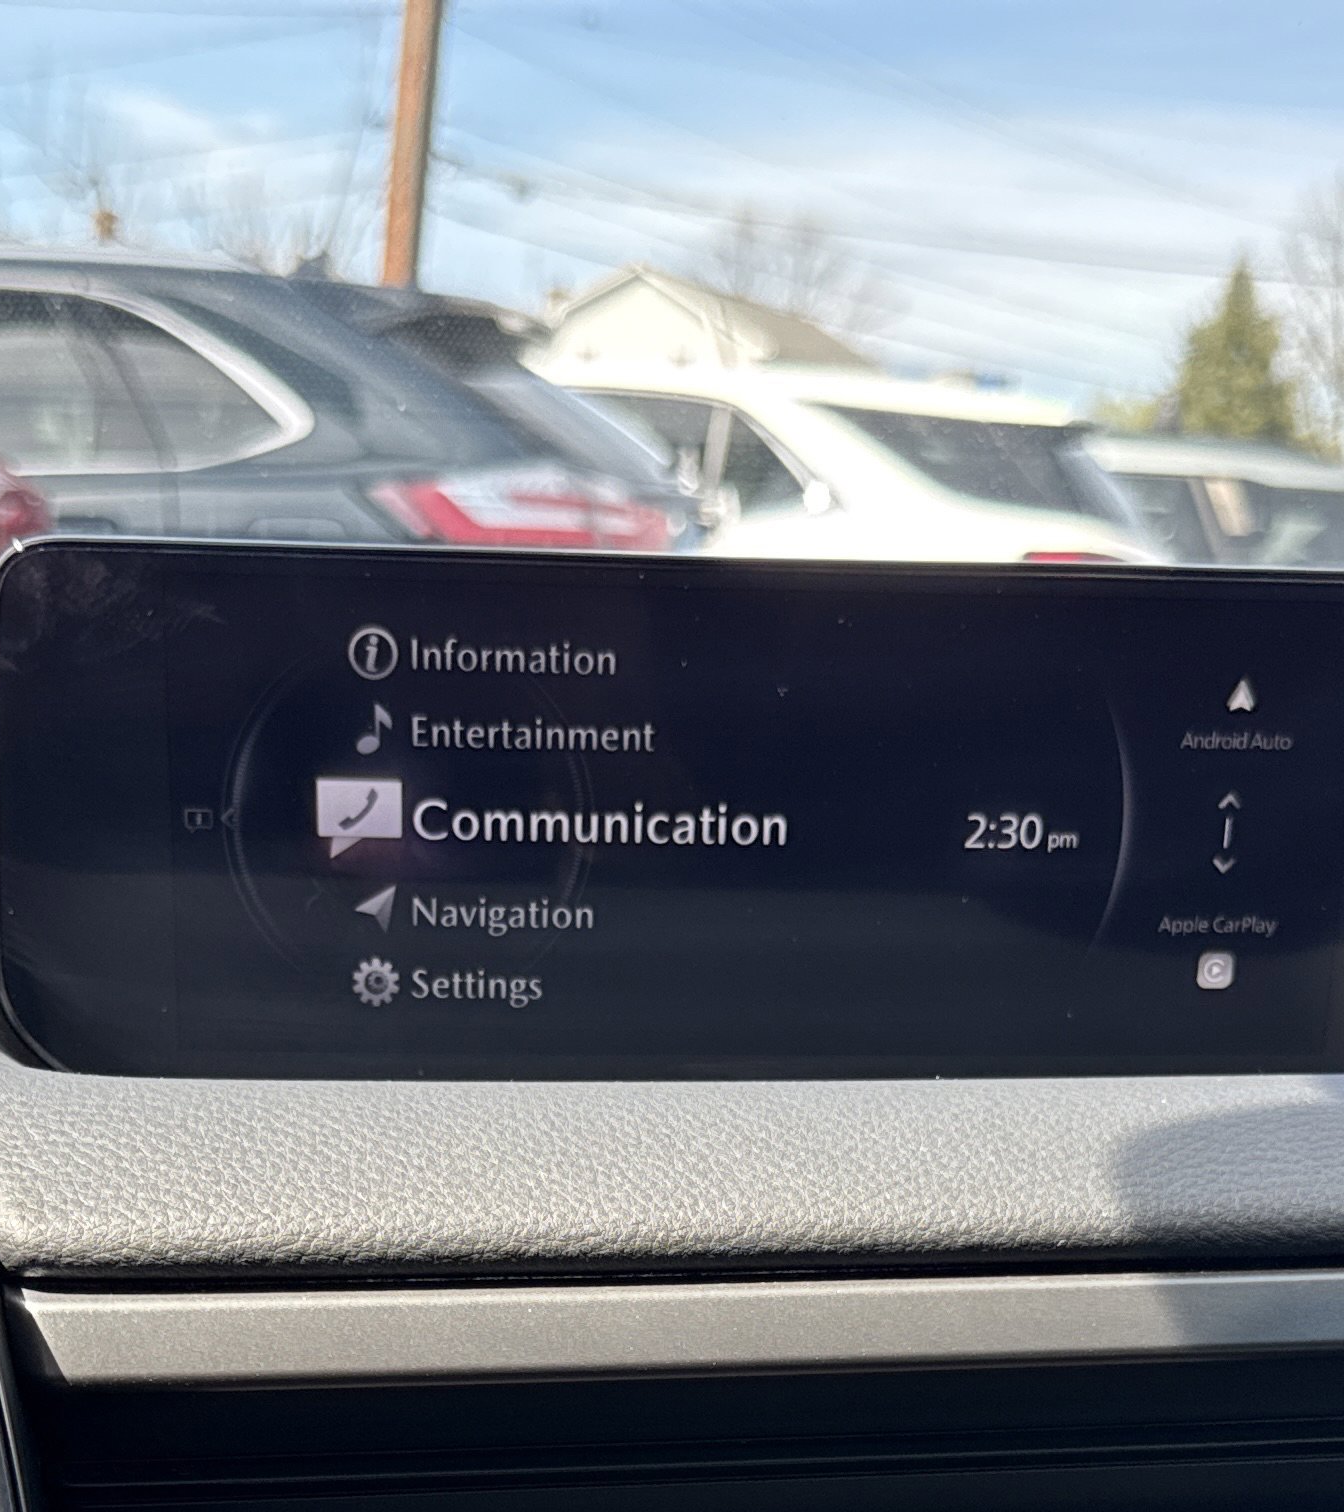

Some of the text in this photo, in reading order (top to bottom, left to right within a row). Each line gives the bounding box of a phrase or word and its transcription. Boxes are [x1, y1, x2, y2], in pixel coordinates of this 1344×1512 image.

[411, 638, 617, 676] Information
[411, 715, 656, 753] Entertainment
[1180, 730, 1293, 751] Android Auto
[412, 798, 788, 847] Communication
[964, 812, 1079, 854] 2:30 pm
[411, 895, 595, 936] Navigation
[1158, 914, 1278, 938] Apple CarPlay
[411, 968, 543, 1007] Settings
